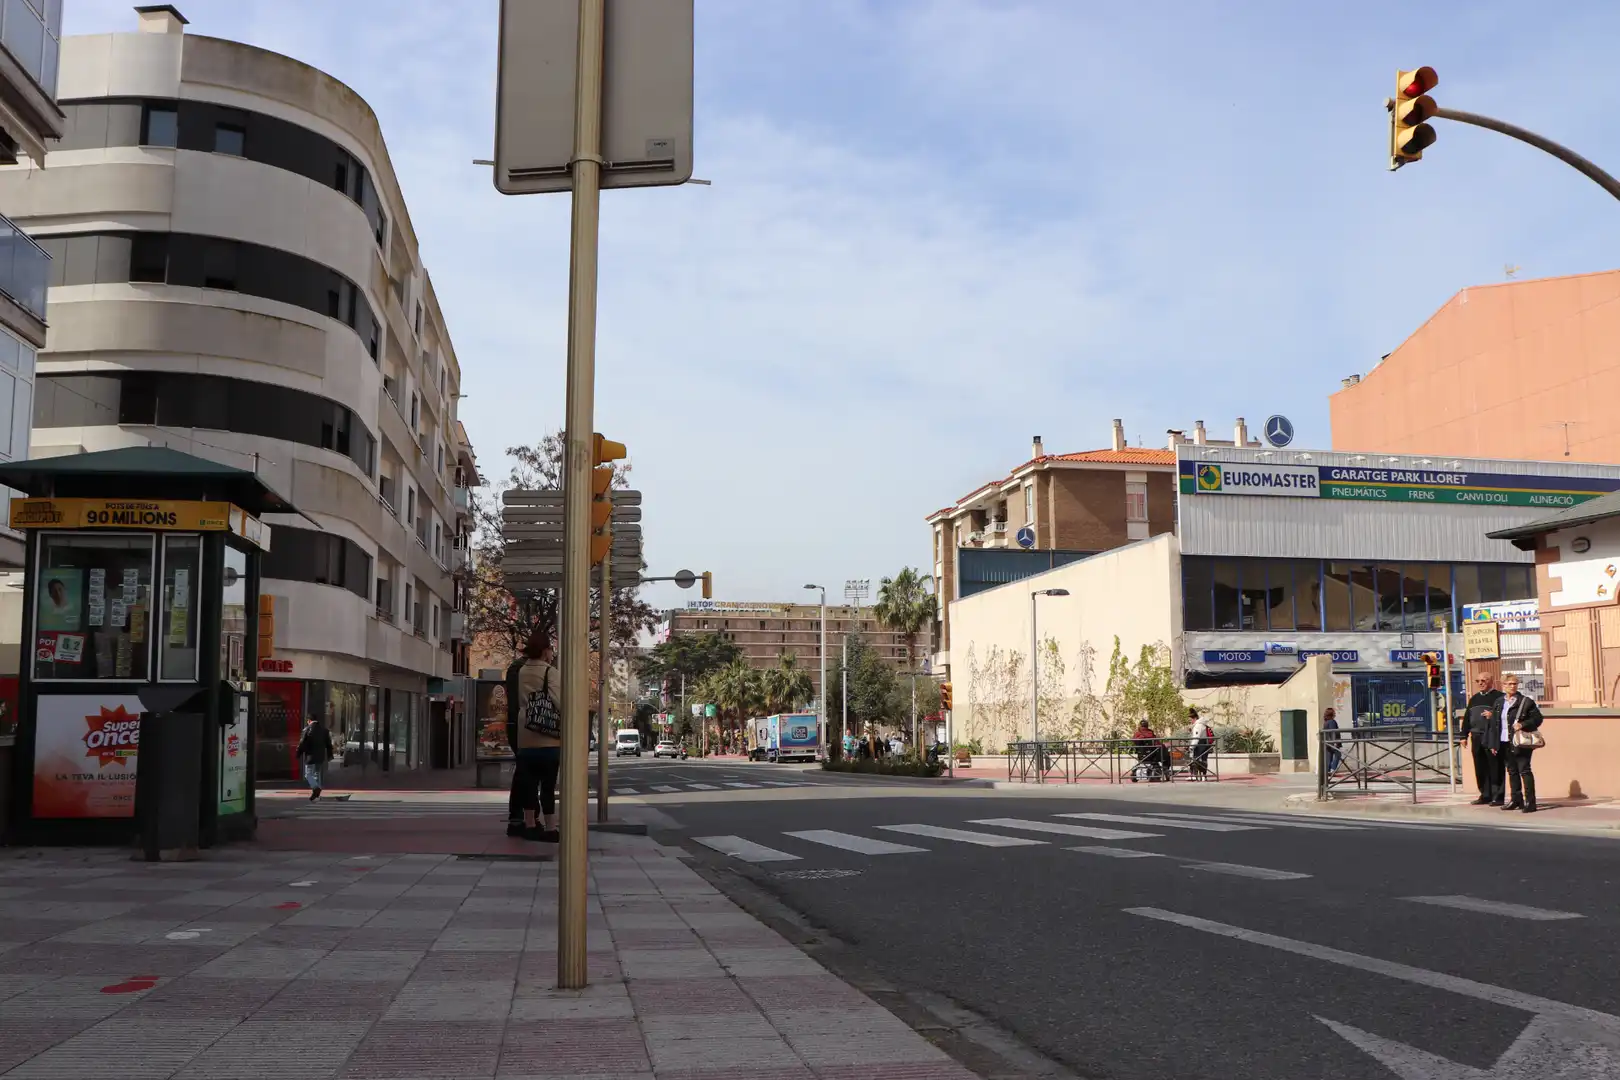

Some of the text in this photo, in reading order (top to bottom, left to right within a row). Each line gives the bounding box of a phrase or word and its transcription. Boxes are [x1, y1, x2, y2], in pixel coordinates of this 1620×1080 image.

[1223, 471, 1317, 489] EUROMASTER
[1331, 469, 1468, 485] GARATGE PARK LLORET
[1332, 486, 1387, 498] PNEUMÀTICS
[1408, 490, 1435, 499] FRENS
[1456, 492, 1484, 501] CANVI
[1529, 494, 1574, 505] ALINEACIÓ
[87, 510, 177, 526] 90 MILIONS
[1218, 652, 1252, 661] MOTOS
[1383, 703, 1401, 717] 80
[87, 729, 139, 748] Once
